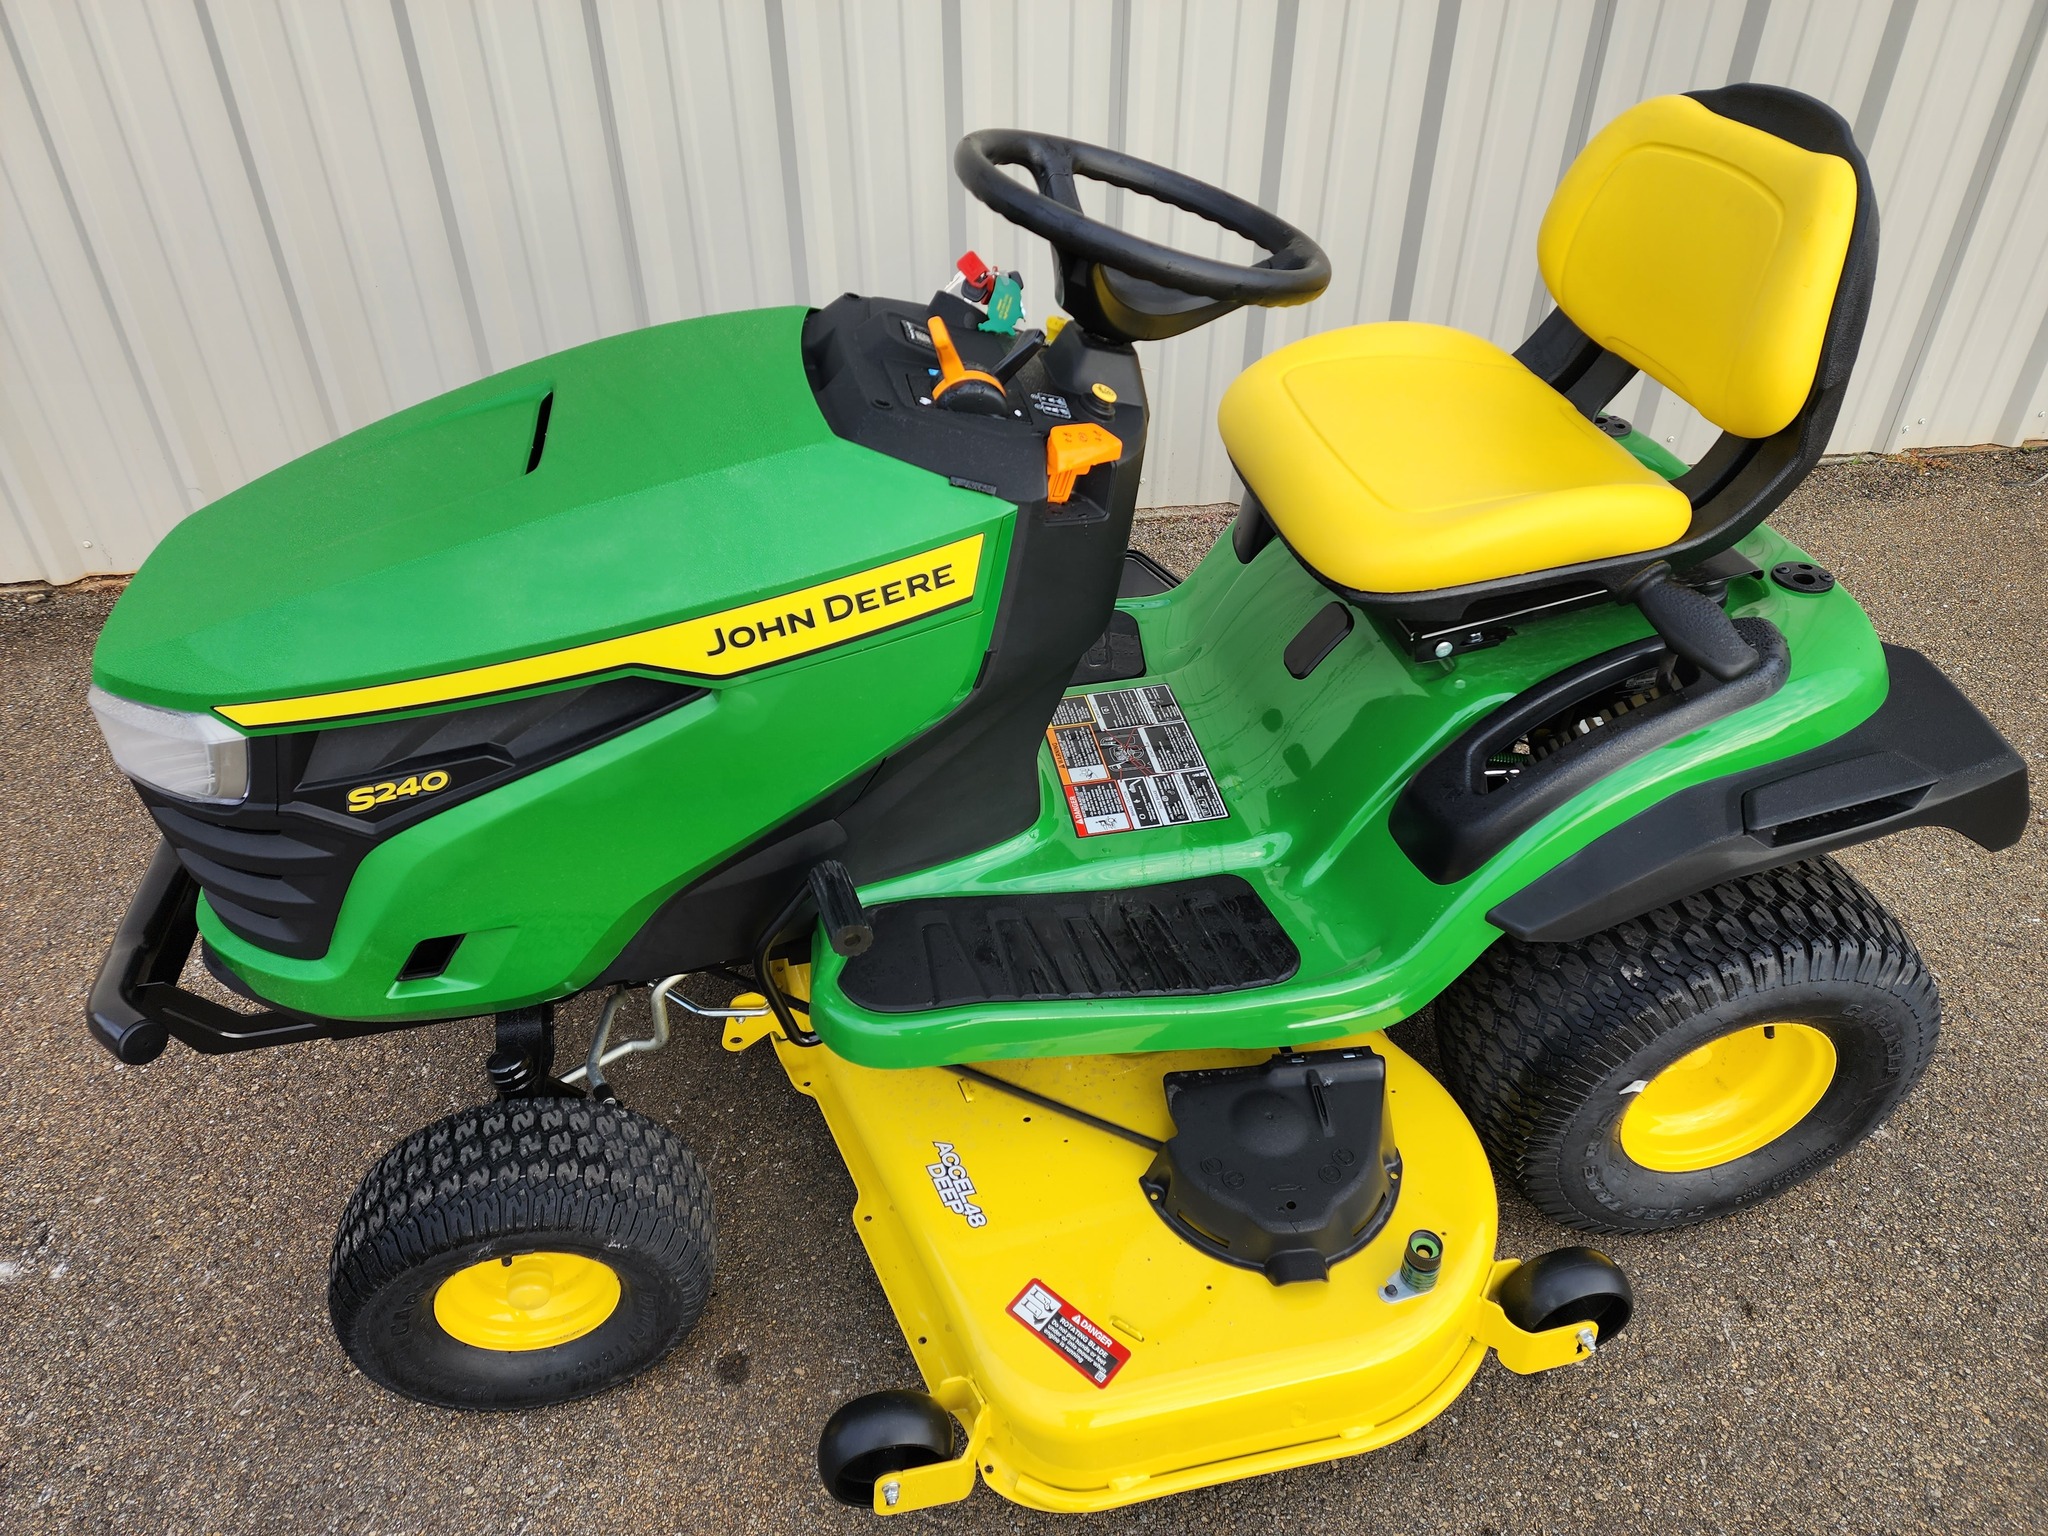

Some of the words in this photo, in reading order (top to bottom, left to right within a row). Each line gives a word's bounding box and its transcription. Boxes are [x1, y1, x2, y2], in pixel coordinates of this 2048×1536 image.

[706, 608, 816, 657] JOHN
[823, 564, 956, 624] DEERE
[1051, 742, 1063, 764] WARNING
[347, 770, 450, 812] S240
[1069, 796, 1081, 818] DANGER
[926, 1162, 965, 1215] DEEP
[1042, 1328, 1060, 1344] engine
[1063, 1346, 1084, 1364] running
[1047, 1324, 1063, 1338] under
[1067, 1340, 1078, 1350] into
[1076, 1348, 1094, 1363] mower
[1092, 1361, 1108, 1374] when
[1051, 1320, 1059, 1328] Do
[1058, 1326, 1068, 1335] not
[1066, 1332, 1076, 1342] put
[1074, 1338, 1091, 1354] hands
[1095, 1355, 1107, 1366] feet
[1059, 1317, 1089, 1343] ROTATING
[1087, 1340, 1109, 1359] BLADE
[1080, 1319, 1113, 1348] DANGER
